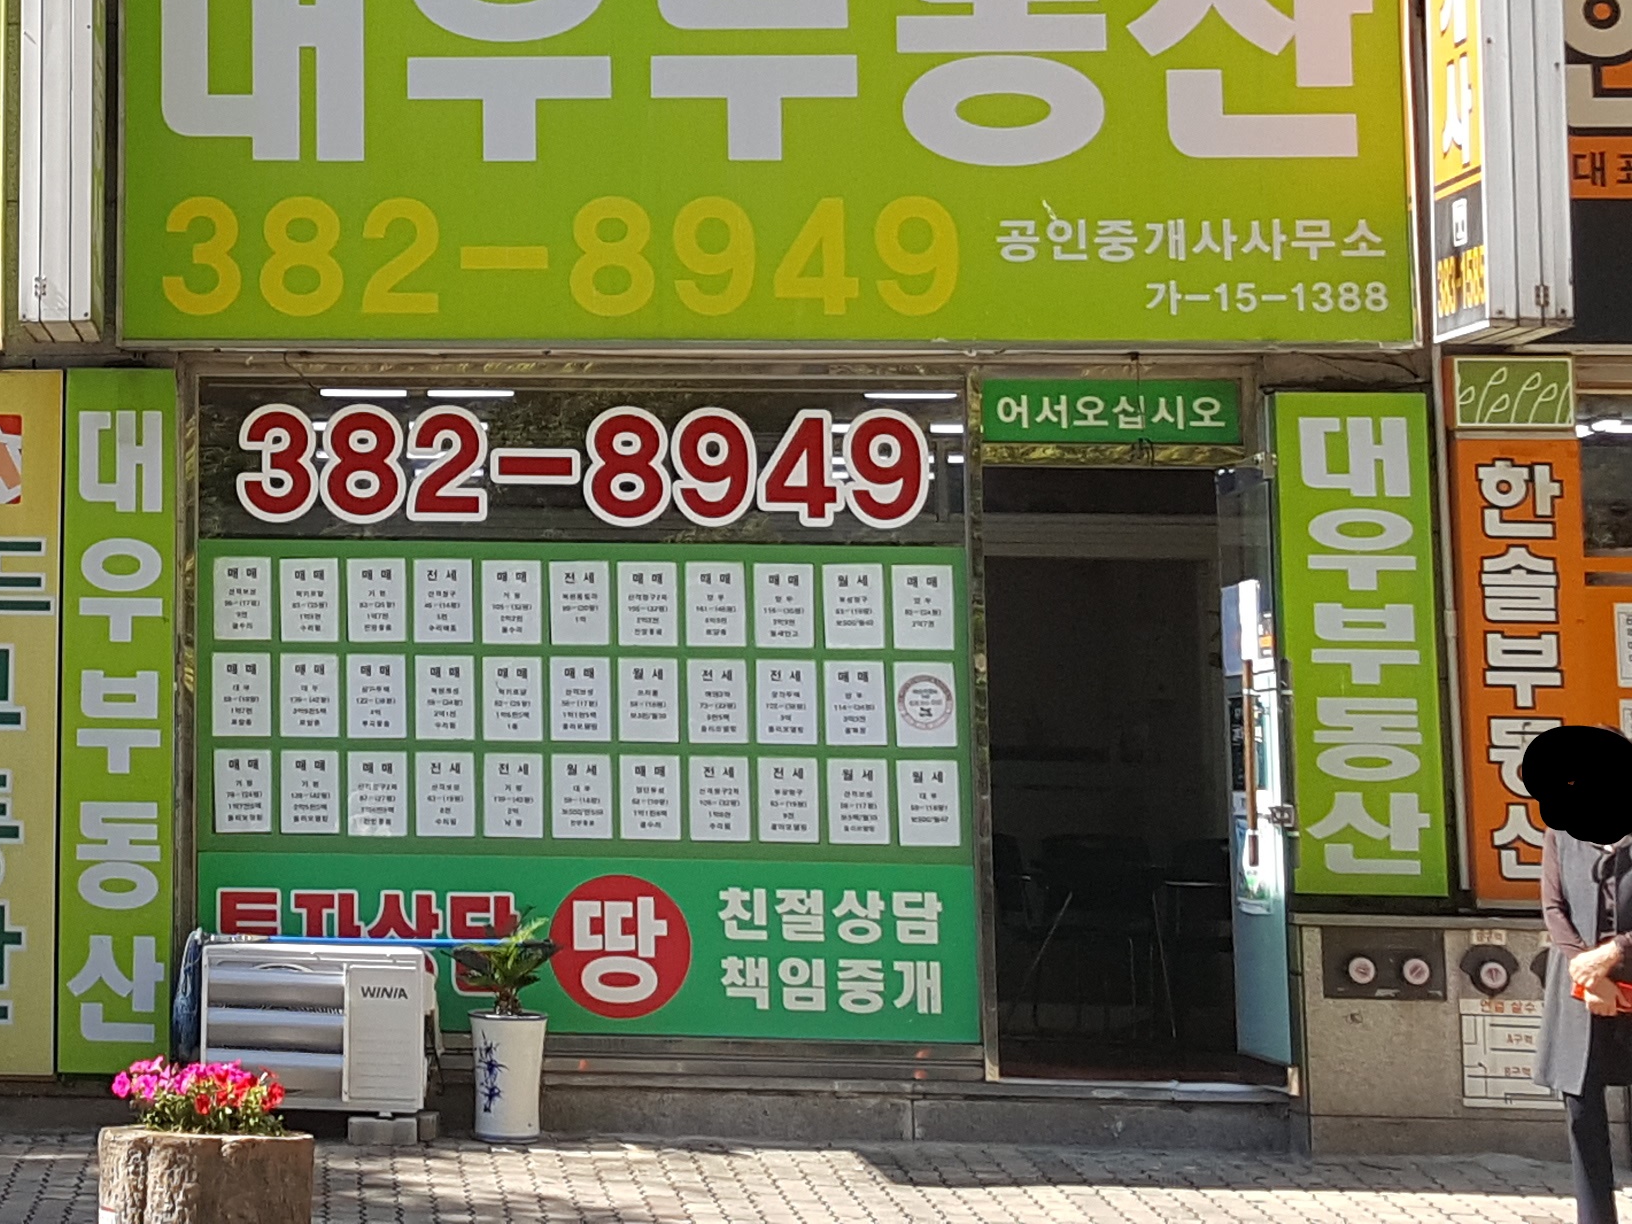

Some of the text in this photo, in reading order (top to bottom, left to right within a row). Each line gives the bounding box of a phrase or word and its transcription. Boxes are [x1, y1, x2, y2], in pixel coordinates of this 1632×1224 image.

[162, 196, 960, 317] 382-8949
[995, 218, 1388, 263] 공인중개사사무소
[1144, 281, 1390, 316] 가-15-1388
[995, 394, 1226, 431] 어서오십시오
[237, 403, 931, 529] 382-8949
[1297, 416, 1431, 877] 대우부동산
[66, 410, 166, 1045] 대우부동산
[717, 886, 943, 945] 친절상담
[572, 894, 668, 1003] 땅
[360, 986, 408, 1001] WINIA
[719, 954, 943, 1016] 책임중개
